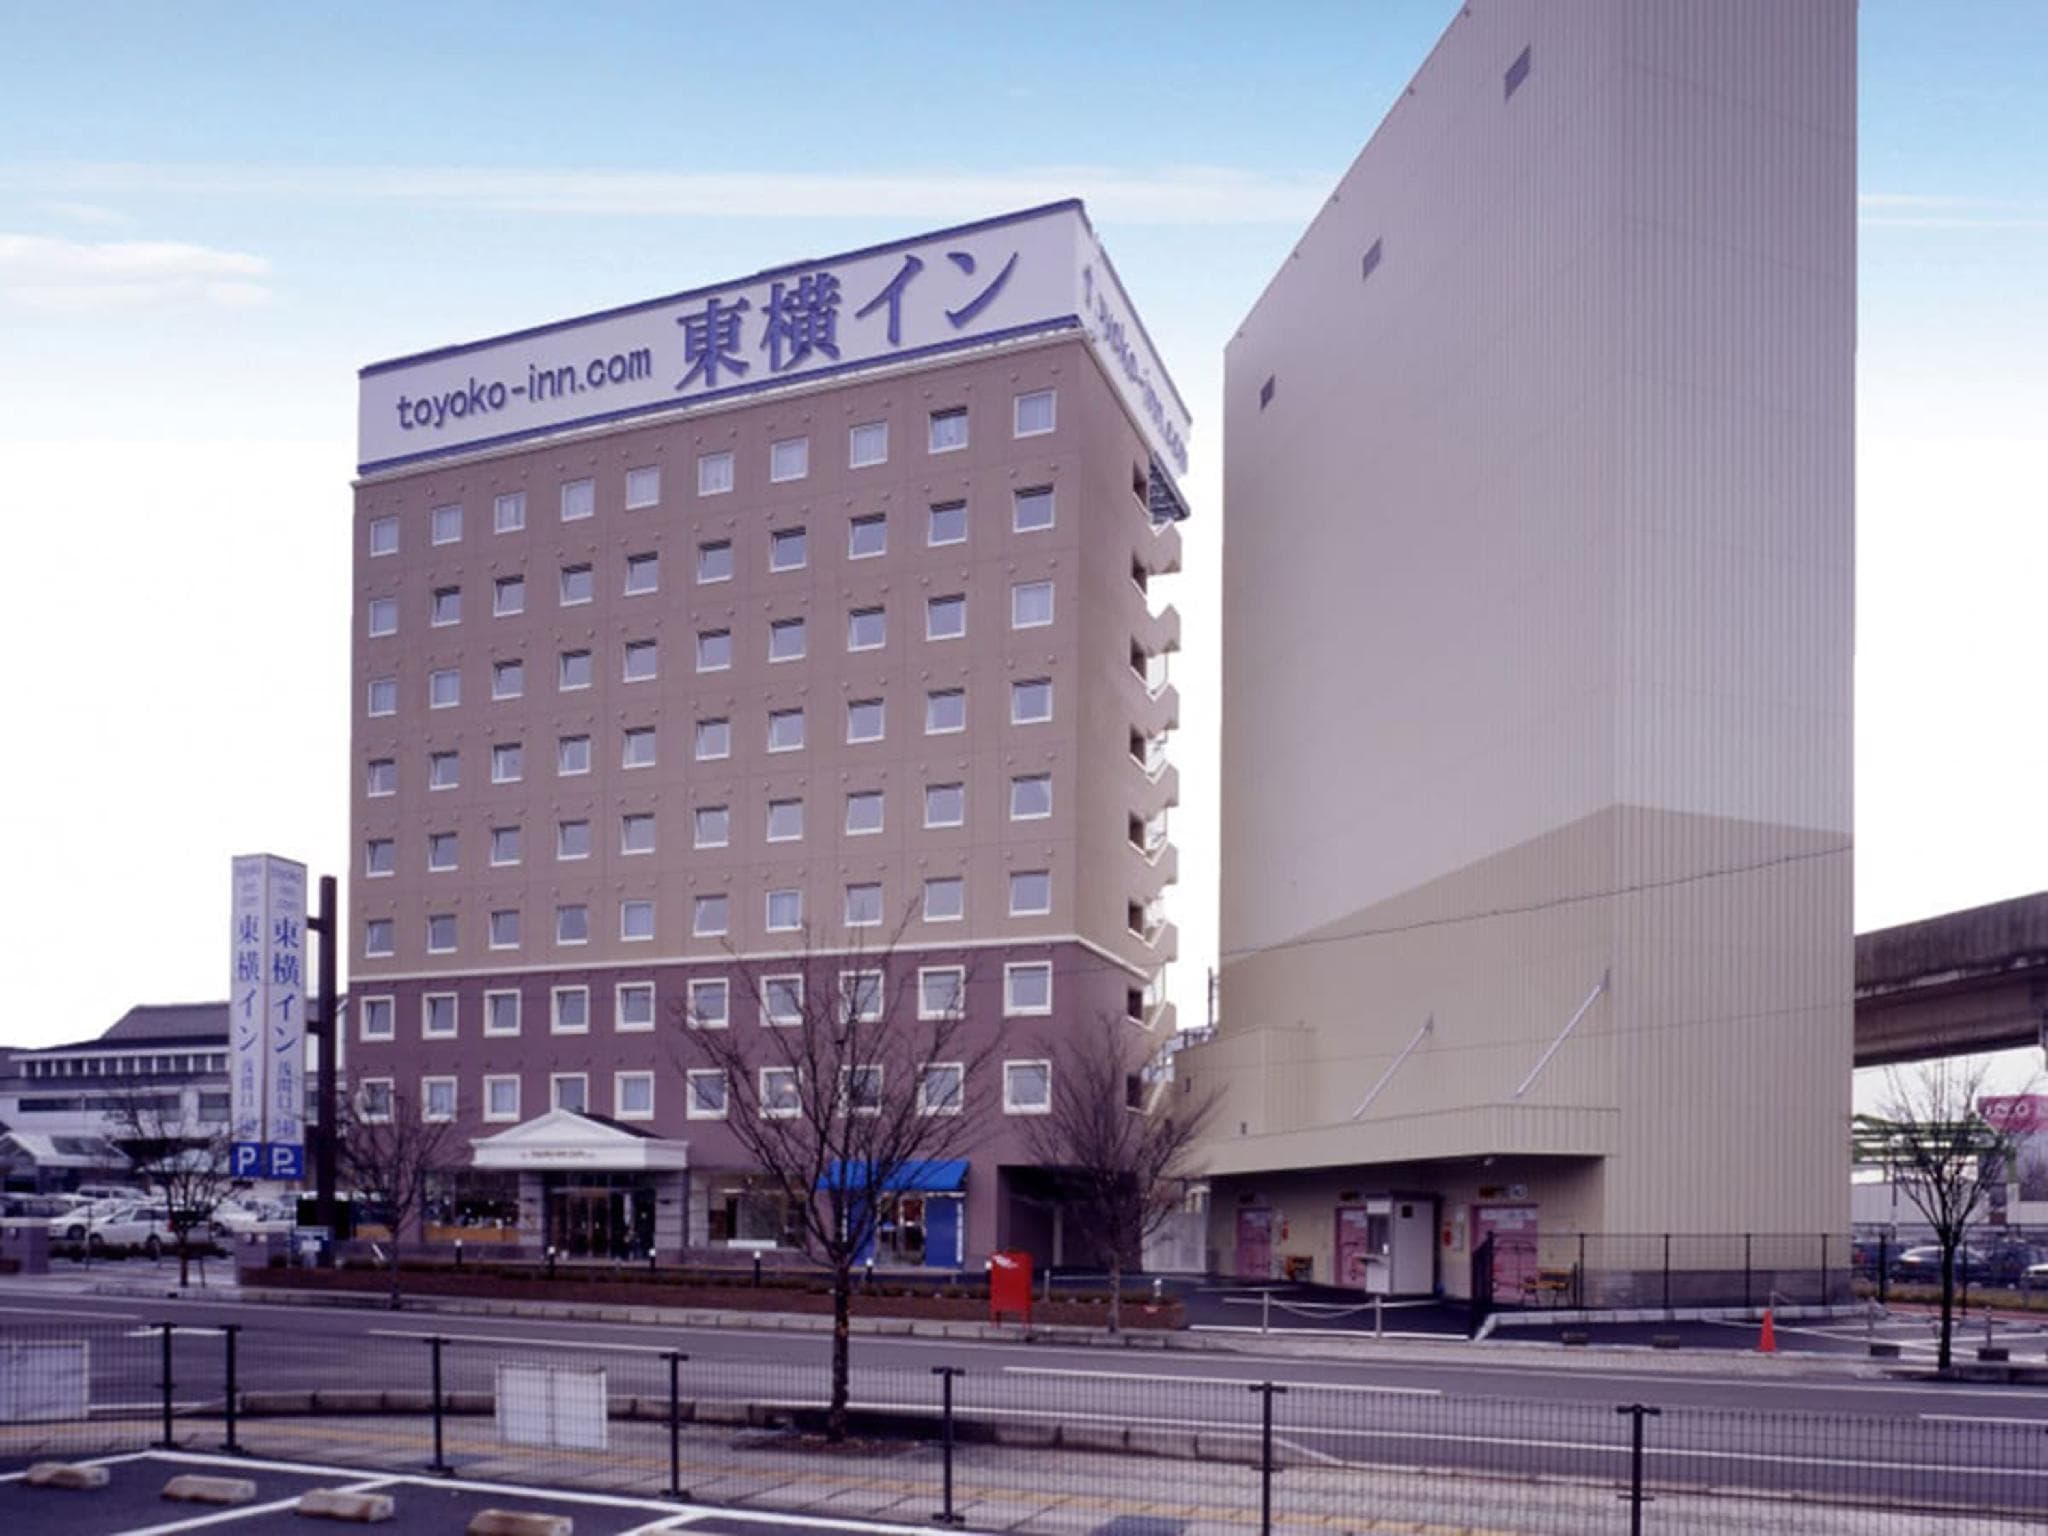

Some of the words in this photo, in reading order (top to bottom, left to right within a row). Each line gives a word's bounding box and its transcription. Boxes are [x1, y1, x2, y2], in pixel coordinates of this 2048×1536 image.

[396, 345, 653, 431] toyoko-inn.com
[675, 250, 1020, 392] 東横イン
[237, 914, 260, 1051] 東横イン
[273, 917, 300, 1052] 東横イン
[237, 1146, 256, 1175] P
[271, 1147, 295, 1175] P
